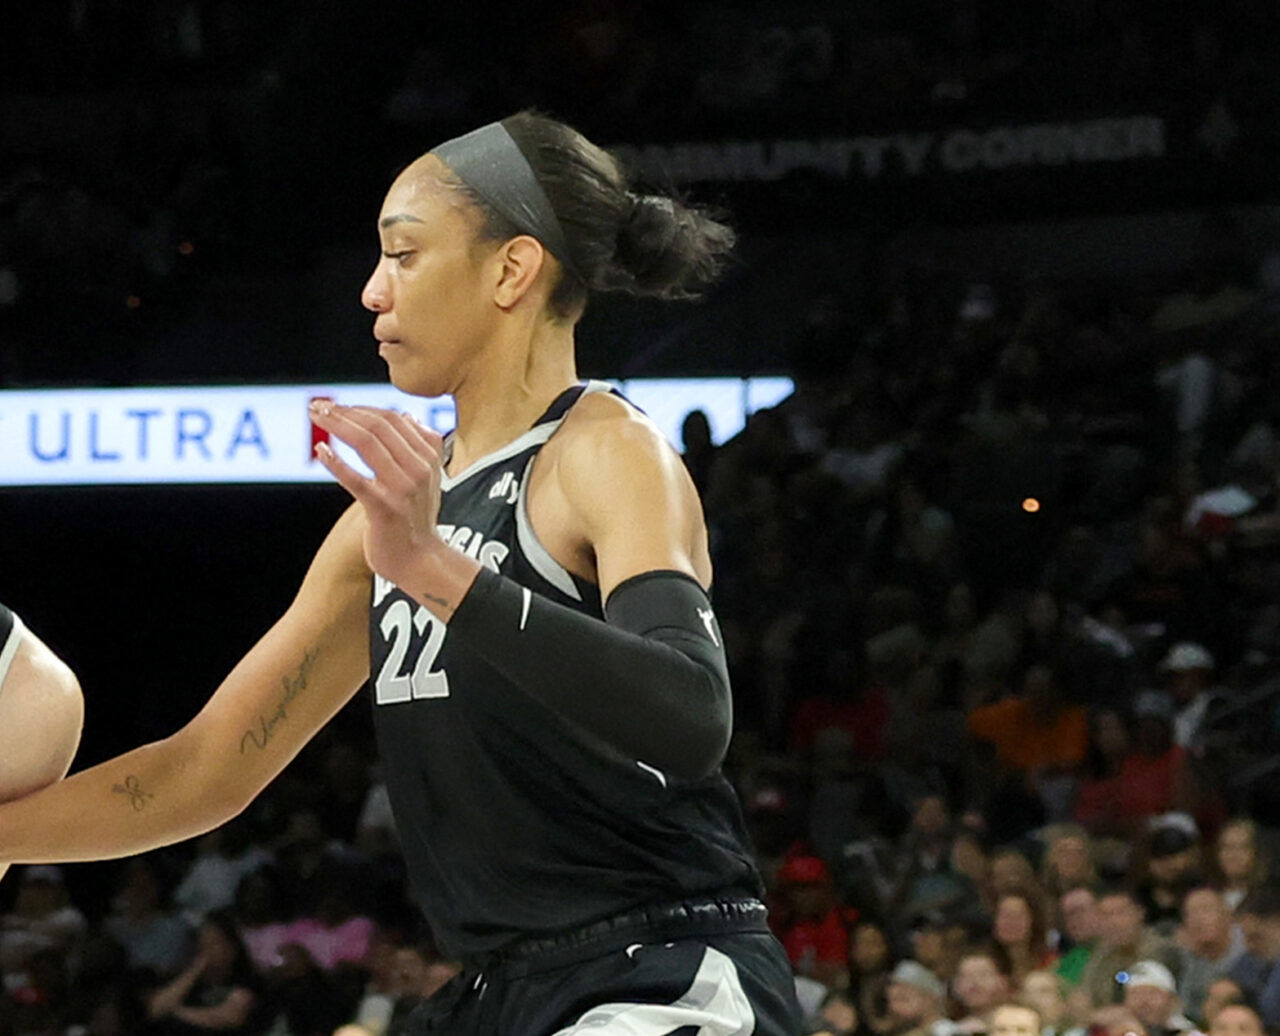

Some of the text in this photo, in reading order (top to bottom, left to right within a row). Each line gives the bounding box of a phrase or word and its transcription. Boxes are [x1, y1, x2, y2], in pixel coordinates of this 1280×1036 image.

[941, 115, 1166, 172] CORNER
[28, 407, 270, 462] ULTRA
[375, 600, 450, 705] 22
